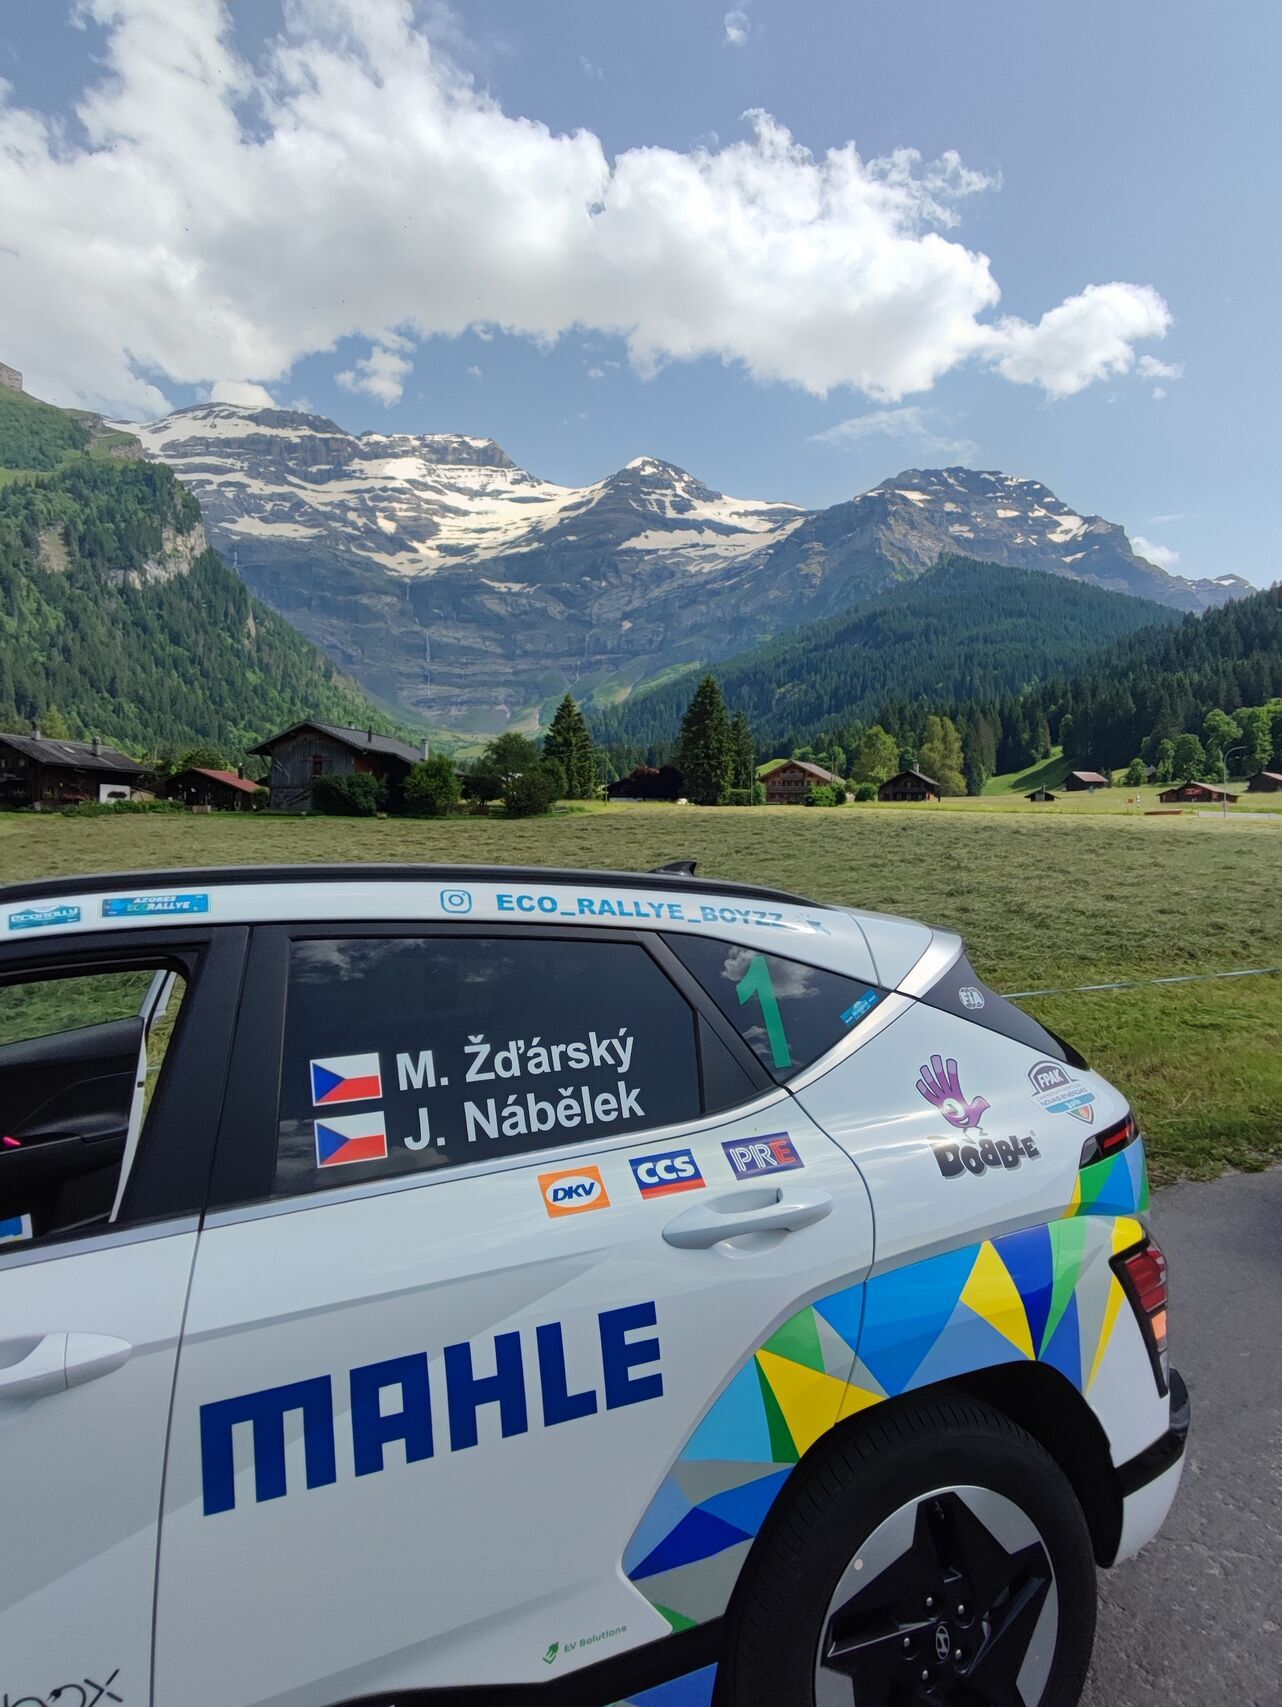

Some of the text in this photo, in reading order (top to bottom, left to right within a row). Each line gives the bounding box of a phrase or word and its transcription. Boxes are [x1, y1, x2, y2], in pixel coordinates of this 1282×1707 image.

[133, 895, 177, 904] AZORES
[736, 955, 793, 1069] 1
[960, 991, 984, 1006] FIA
[396, 1027, 635, 1091] M. Žďárský
[1036, 1068, 1065, 1088] FPAK
[403, 1080, 646, 1152] J. Nábělek
[636, 1155, 696, 1184] CCS
[729, 1138, 796, 1173] PRE
[552, 1181, 596, 1203] DKV
[199, 1300, 664, 1517] MAHLE
[564, 1625, 627, 1653] EV Solutions
